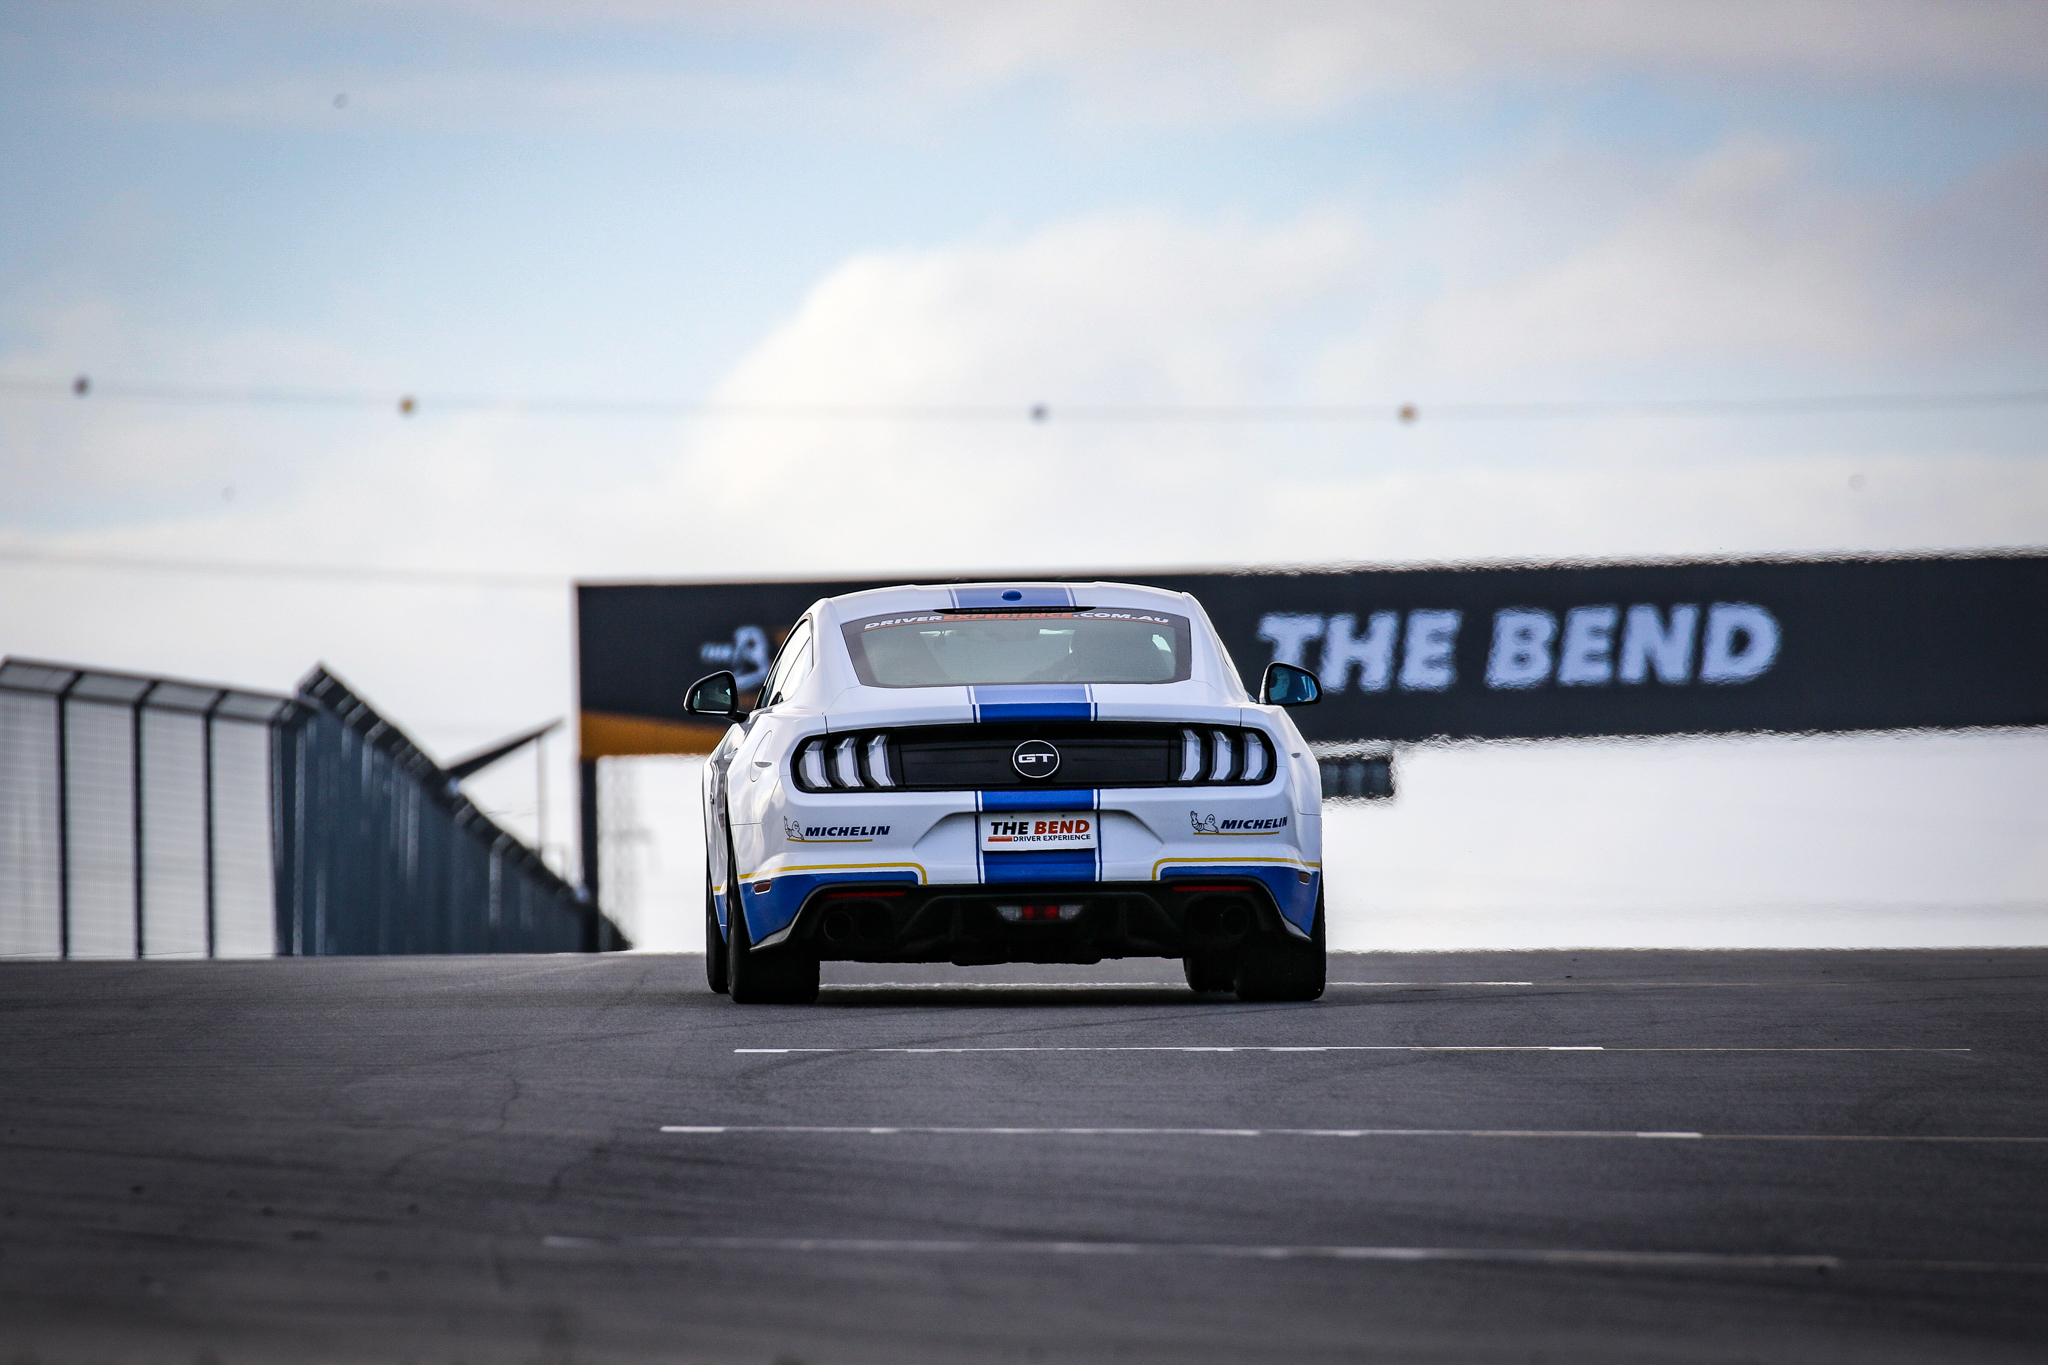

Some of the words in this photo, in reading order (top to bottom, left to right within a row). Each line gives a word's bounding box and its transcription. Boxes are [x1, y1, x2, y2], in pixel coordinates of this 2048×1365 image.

[1258, 609, 1460, 691] THE
[1485, 603, 1781, 689] BEND
[1018, 753, 1054, 763] GT
[991, 821, 1029, 835] THE
[1034, 820, 1091, 834] BEND
[1220, 816, 1288, 830] MICHELIN
[805, 825, 891, 837] MICHELIN
[1043, 834, 1091, 842] EXPERIENCE
